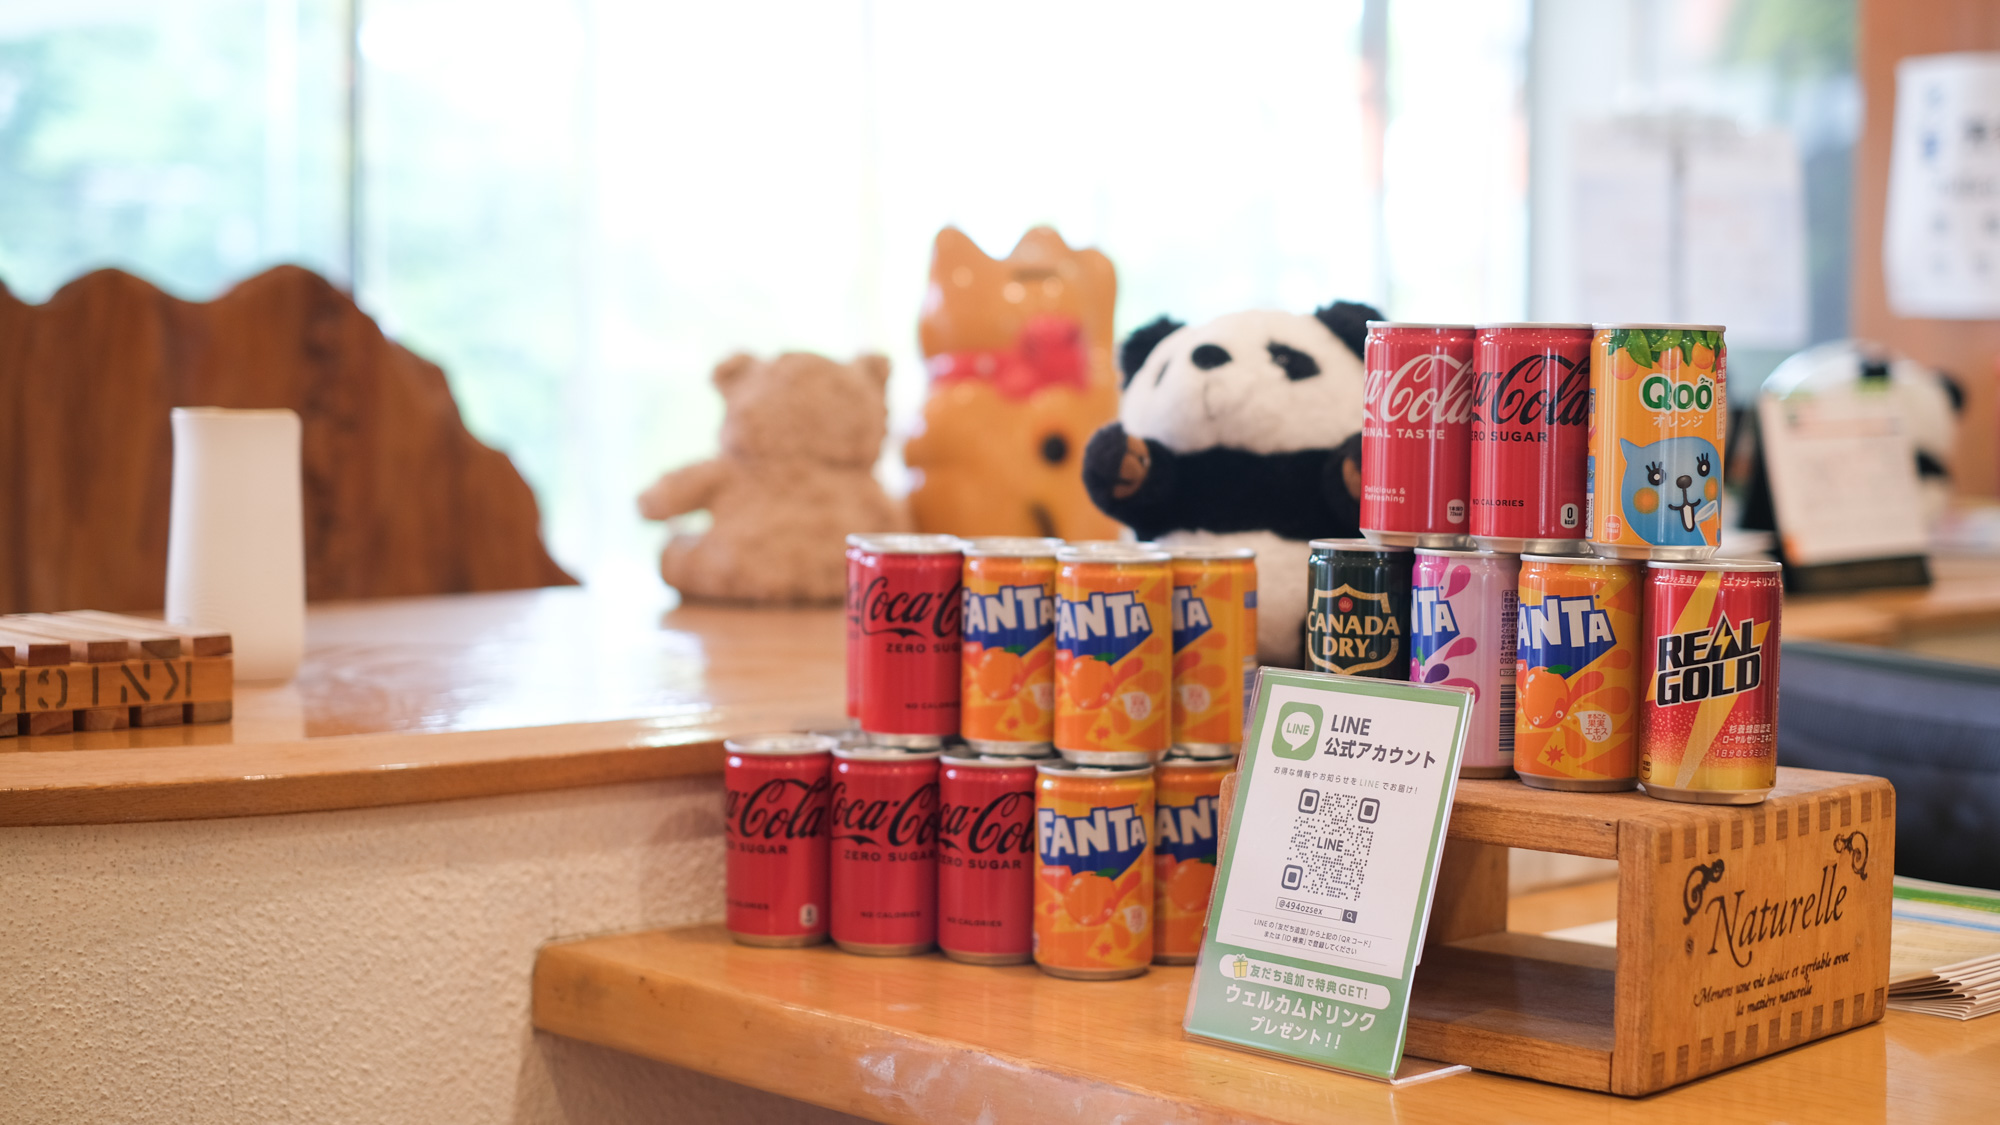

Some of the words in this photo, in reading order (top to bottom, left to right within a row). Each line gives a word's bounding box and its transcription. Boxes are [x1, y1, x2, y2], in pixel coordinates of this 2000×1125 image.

[1653, 415, 1705, 428] オレンジ
[1396, 428, 1445, 440] TASTE
[1490, 431, 1548, 442] SUGAR
[1365, 485, 1397, 495] Delicious
[1365, 493, 1405, 504] Refreshing
[1481, 499, 1525, 507] CALORIES
[1567, 506, 1574, 519] 0
[1564, 518, 1576, 526] kcal
[1307, 611, 1400, 635] CANADA
[886, 643, 926, 653] ZERO
[1323, 636, 1371, 658] DRY
[1657, 611, 1762, 672] REAL
[1656, 653, 1761, 707] GOLD
[1286, 723, 1310, 736] LINE
[1331, 715, 1372, 736] LINE
[1585, 728, 1608, 736] エキス
[1323, 737, 1436, 769] 公式アカウント
[1038, 807, 1147, 857] FANTA
[740, 842, 789, 854] SUGAR
[1316, 837, 1344, 852] LINE
[844, 851, 882, 862] ZERO
[967, 859, 1022, 870] SUGAR
[1278, 899, 1323, 915] @494ozsex
[1705, 863, 1848, 968] Naturelle
[959, 918, 1003, 927] CALORIES
[1250, 963, 1369, 1000] 友だち追加で特典GET!
[1767, 968, 1789, 986] douce
[1226, 984, 1376, 1032] ウェルカムドリンク
[1251, 1015, 1342, 1050] プレゼント!!
